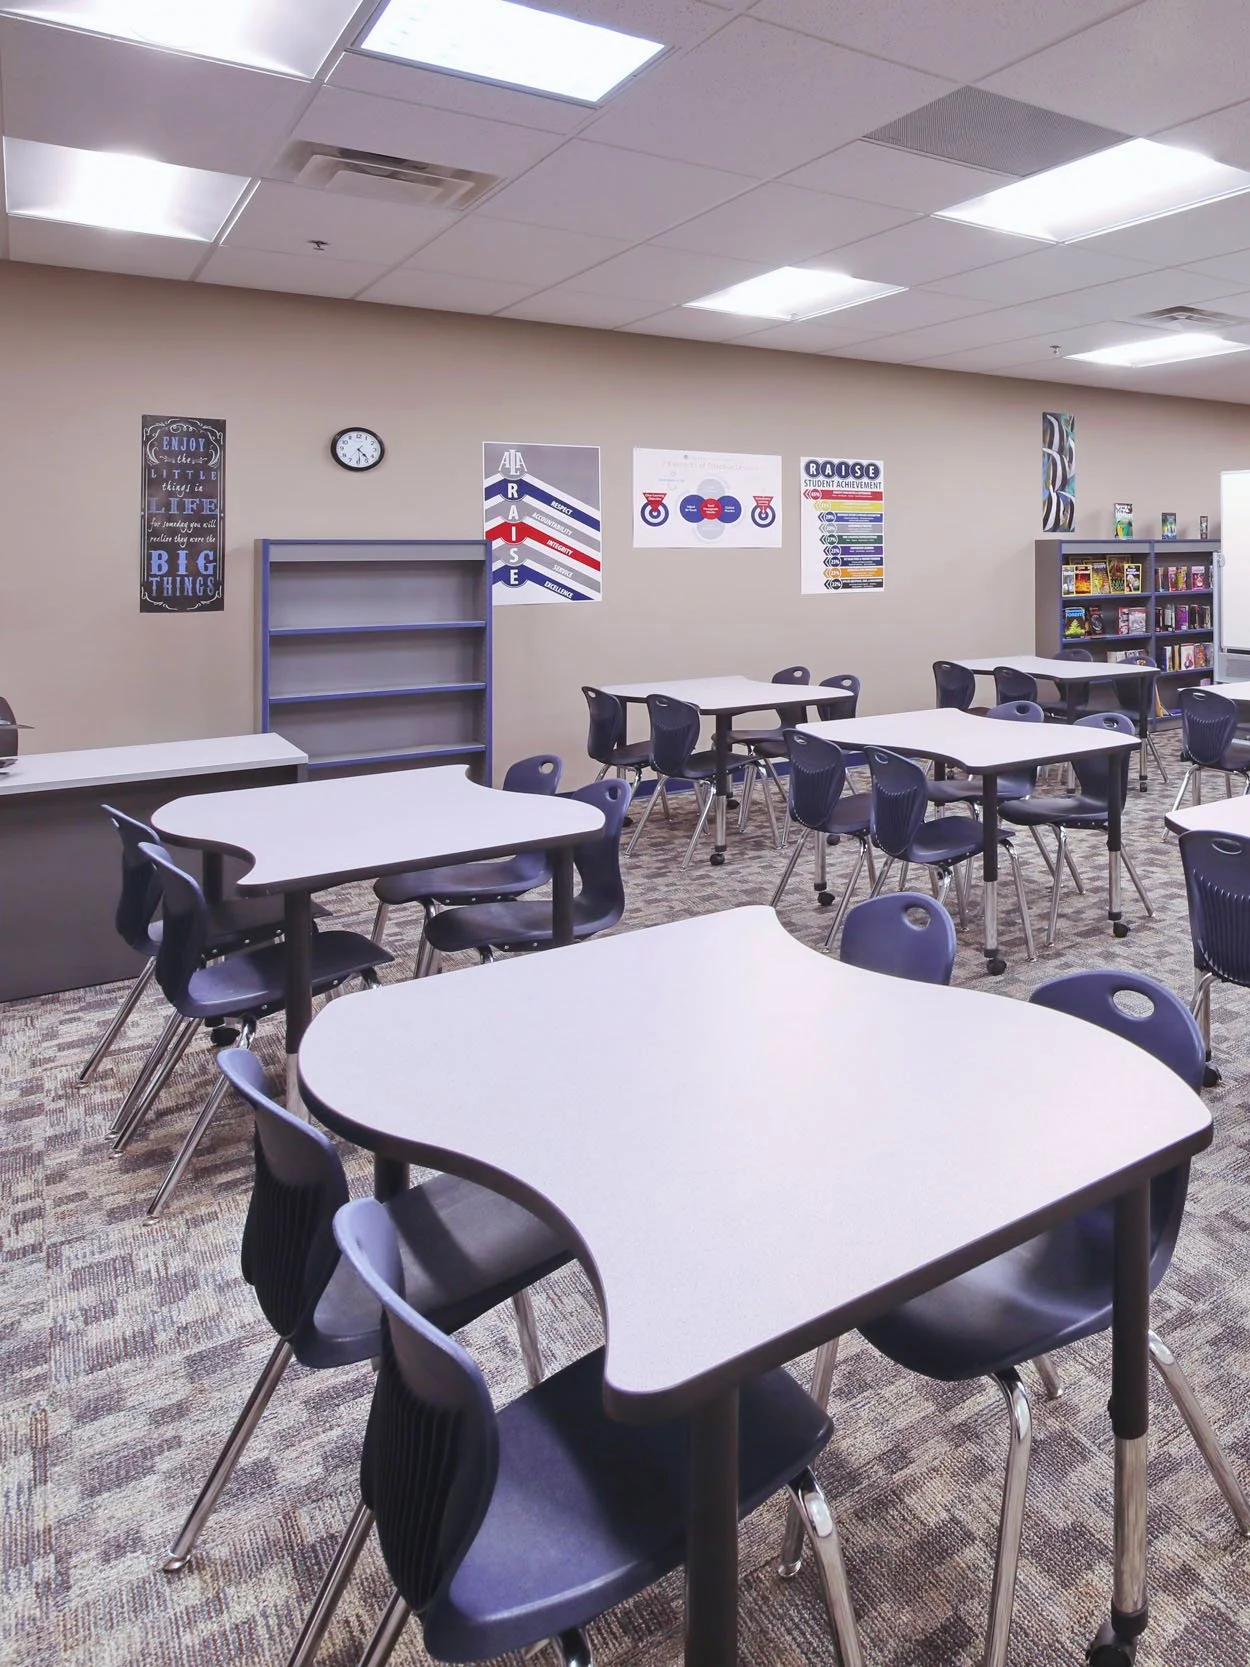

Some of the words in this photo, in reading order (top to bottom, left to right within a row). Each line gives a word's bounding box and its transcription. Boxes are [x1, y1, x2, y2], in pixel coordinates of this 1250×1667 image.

[163, 437, 205, 451] ENJOY
[177, 454, 191, 463] the
[151, 469, 216, 480] LITTLE
[810, 463, 875, 477] RAISE
[162, 481, 190, 497] things
[195, 483, 203, 491] in
[804, 480, 834, 488] STUDENT
[836, 481, 882, 489] ACHIEVEMENT
[148, 498, 218, 514] LIFE
[551, 500, 573, 516] RESPECT
[148, 518, 160, 532] for
[163, 520, 188, 533] someday
[186, 522, 201, 533] you
[203, 520, 216, 528] will
[532, 512, 572, 536] ACCOUNTABILITY
[174, 534, 188, 548] they
[206, 534, 215, 542] the
[547, 540, 573, 556] INTEGRITY
[149, 550, 216, 575] BIG
[553, 564, 573, 578] SERVICE
[149, 577, 214, 596] THINGS
[544, 581, 574, 599] EXCELLENCE
